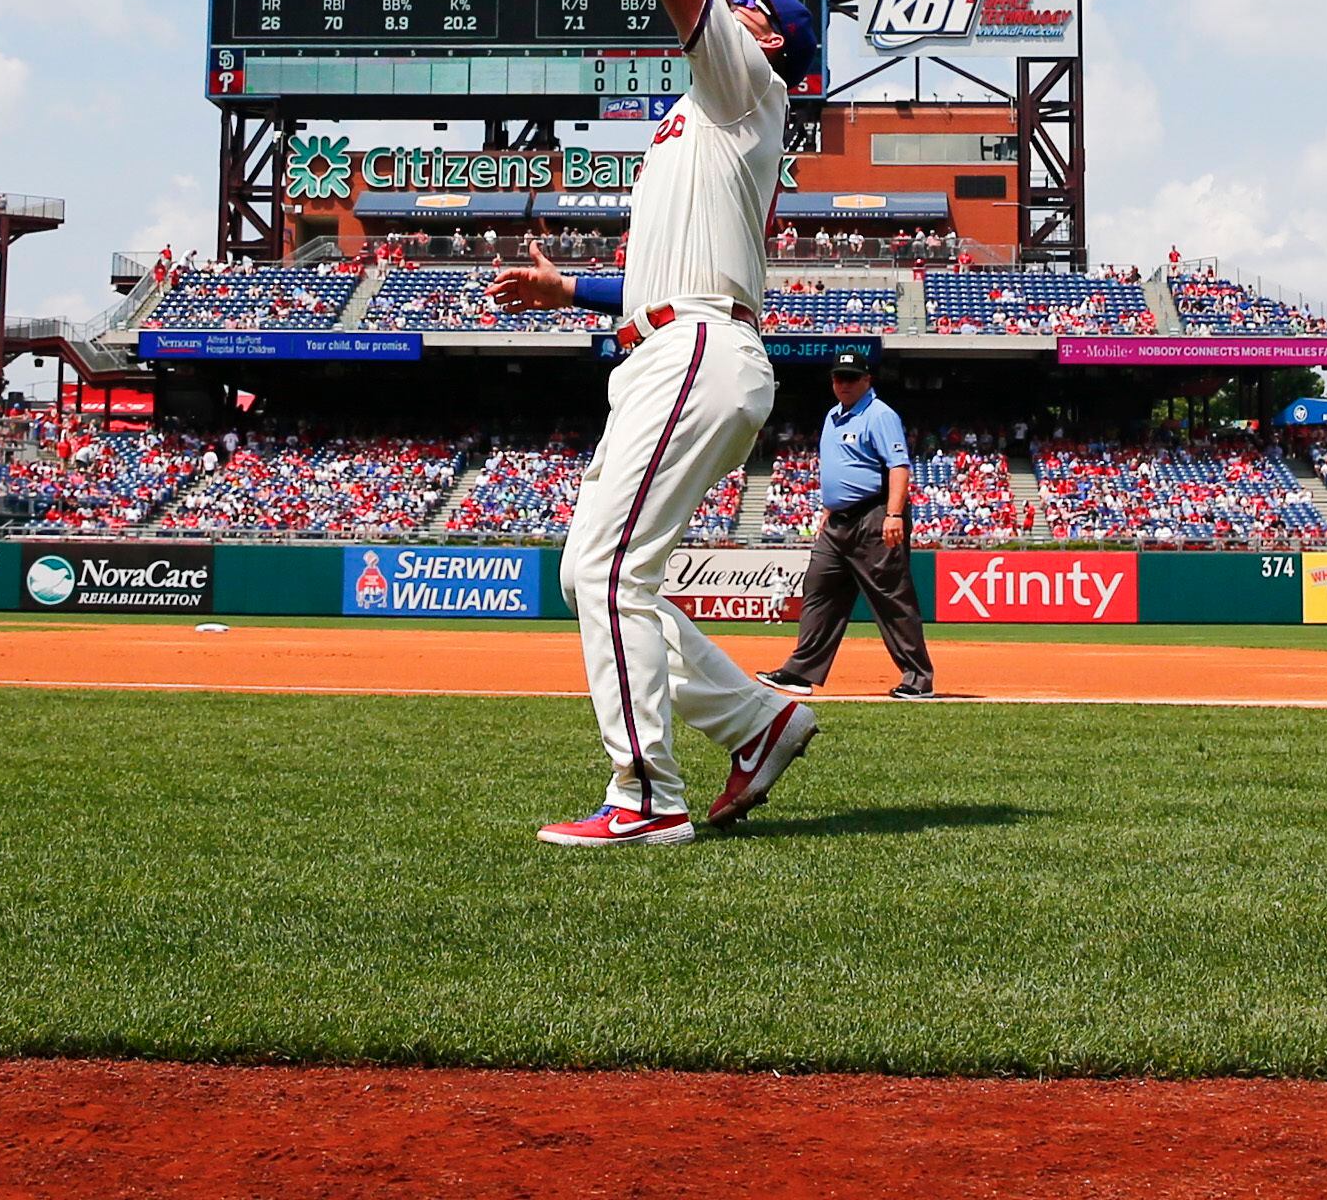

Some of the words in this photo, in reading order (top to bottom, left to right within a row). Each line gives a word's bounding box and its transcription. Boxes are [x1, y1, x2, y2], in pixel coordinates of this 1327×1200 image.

[261, 17, 281, 30] 26
[324, 17, 343, 30] 70
[385, 16, 409, 30] 8.9
[443, 16, 477, 30] 20.2
[979, 10, 1072, 25] TECHNOLOGY
[362, 147, 552, 188] Citizens
[562, 147, 644, 188] Ban
[157, 336, 201, 348] Nemours
[306, 340, 326, 350] Your
[328, 340, 351, 350] child.
[354, 340, 370, 350] Our
[372, 340, 410, 351] promise.
[1086, 344, 1127, 357] Mobile
[1138, 346, 1182, 356] NOBODY
[1183, 347, 1240, 356] CONNECTS
[1241, 347, 1272, 356] MORE
[1273, 347, 1317, 356] PHILLIES
[395, 551, 523, 580] SHERWIN
[1261, 557, 1295, 578] 374
[78, 559, 206, 588] NovaCare
[949, 557, 1124, 620] xfinity
[78, 593, 201, 606] REHABILITATION
